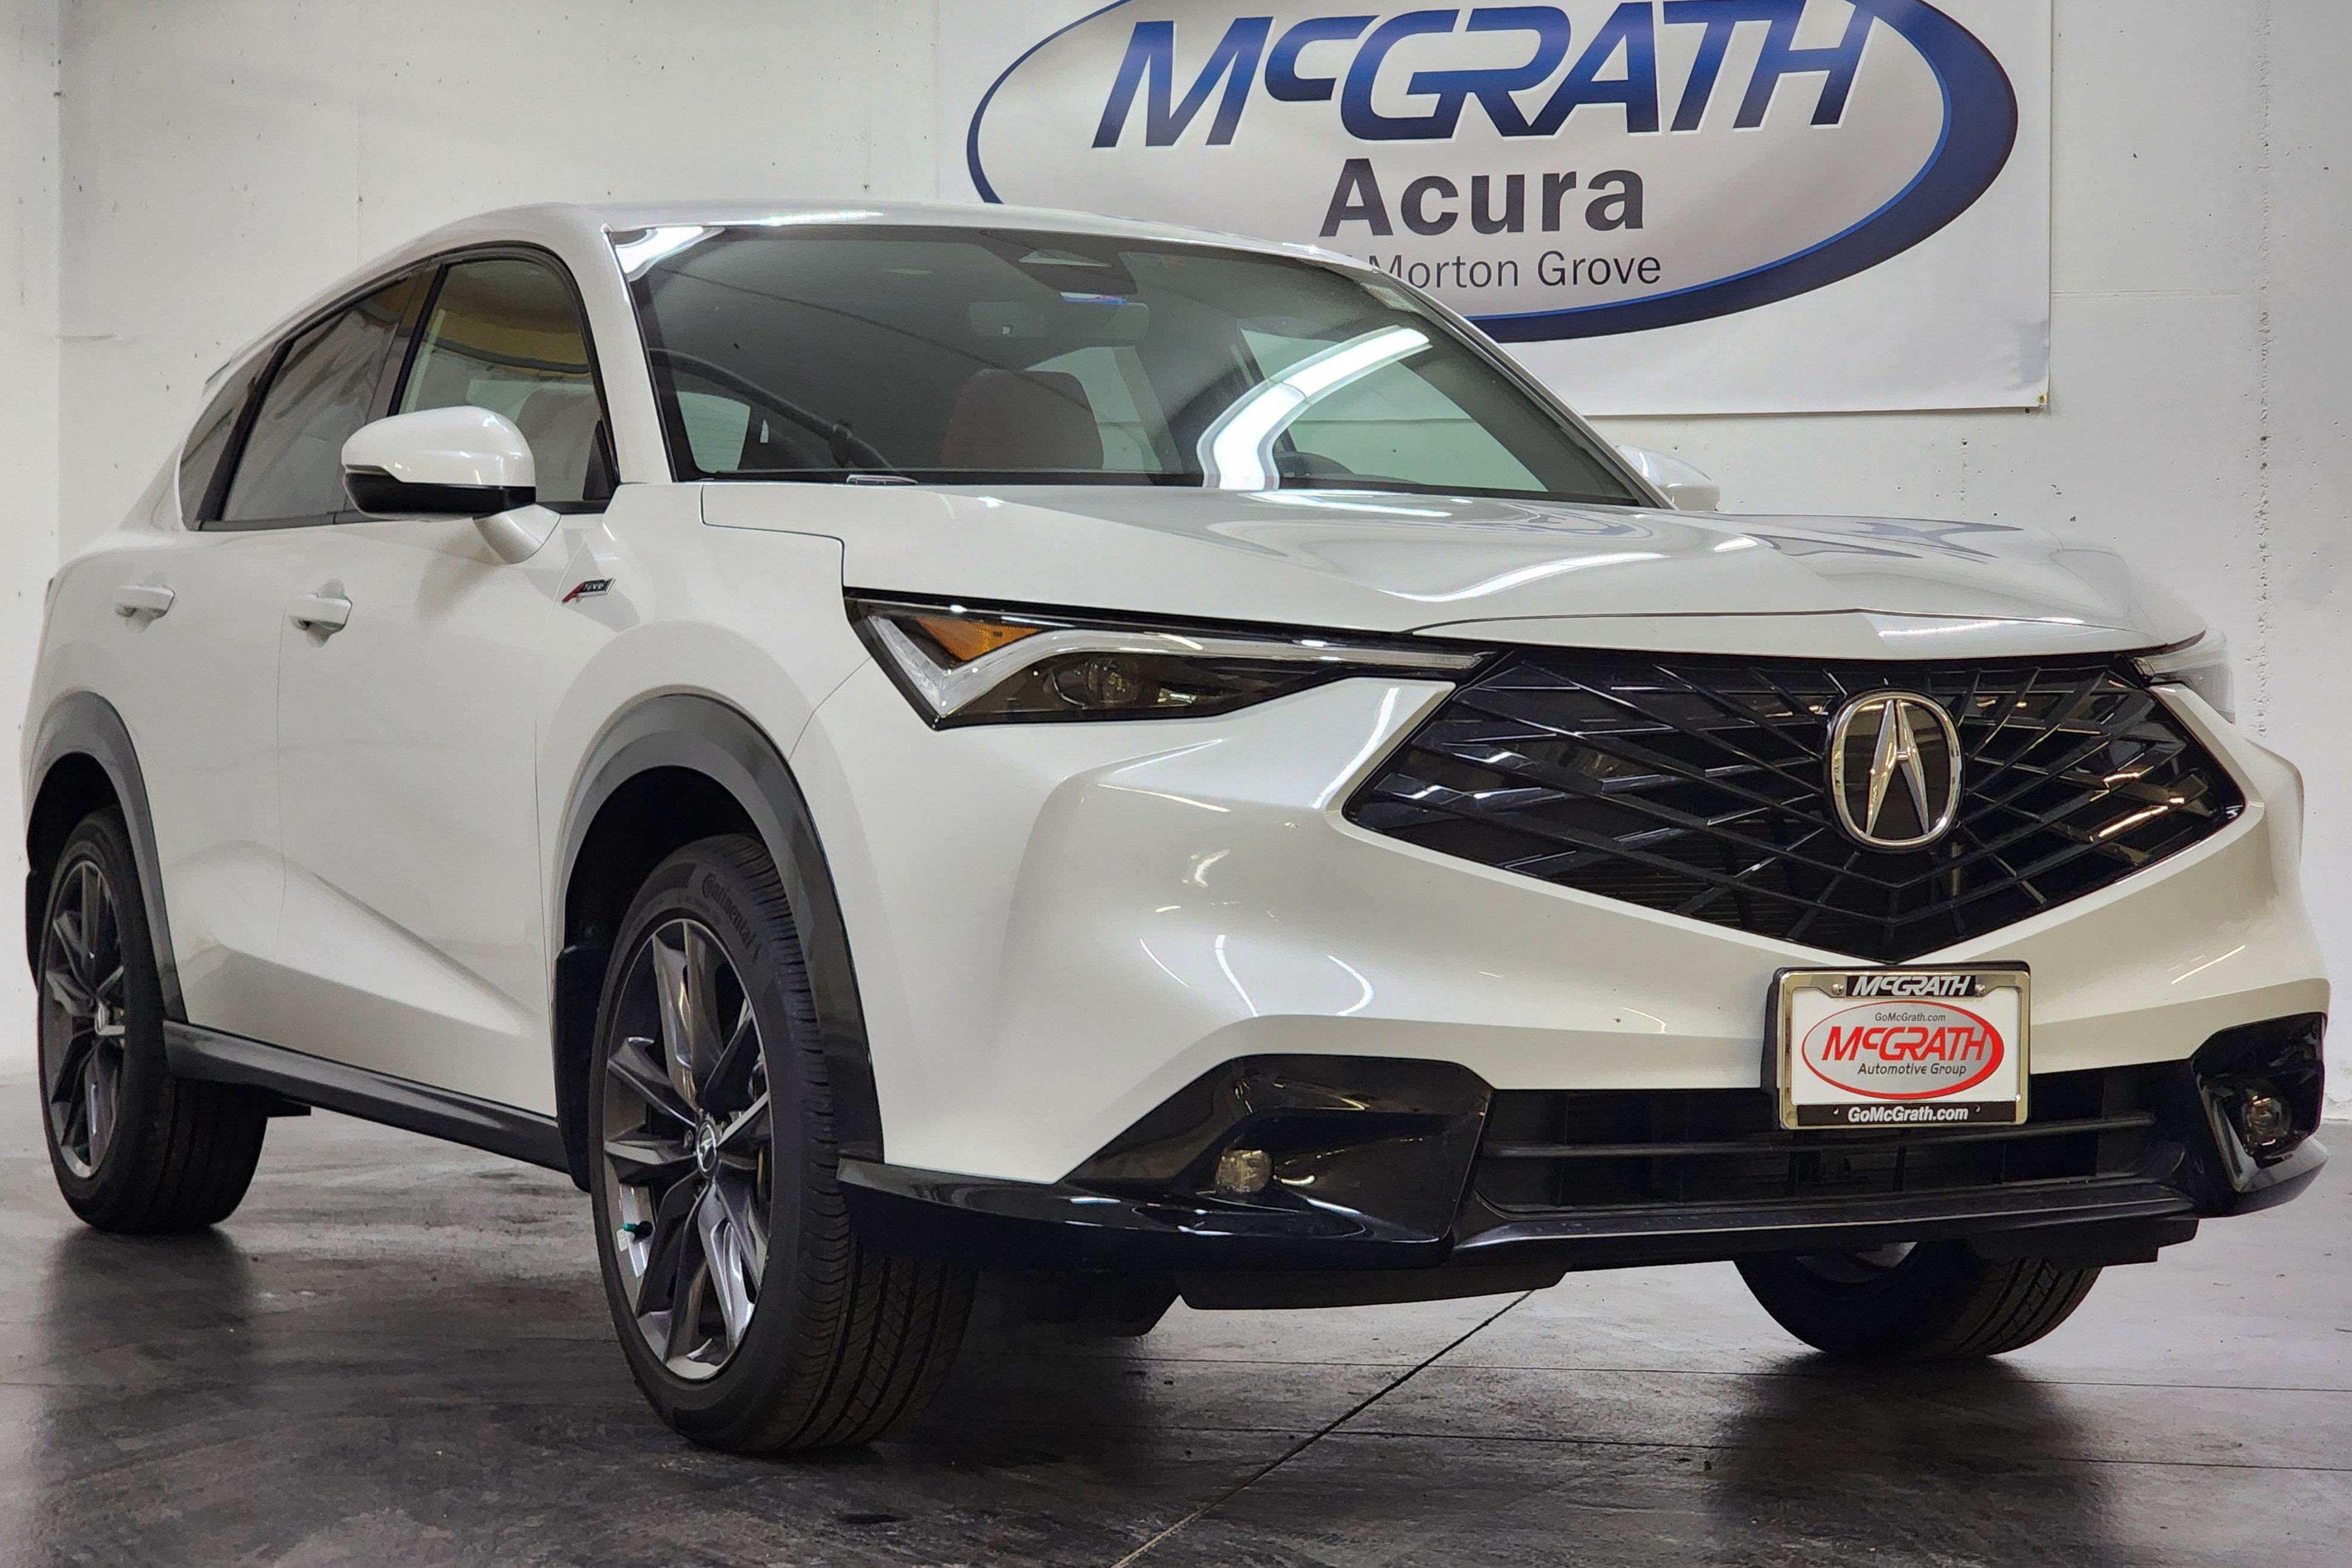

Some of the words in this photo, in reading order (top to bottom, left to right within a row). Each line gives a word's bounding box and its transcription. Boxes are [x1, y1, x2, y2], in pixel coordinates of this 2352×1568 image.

[1319, 157, 1644, 237] Acura
[1538, 250, 1662, 286] Grove
[702, 873, 758, 949] Continental
[1874, 1012, 1946, 1022] GoMcGrath.com
[1858, 1063, 1927, 1075] Automotive
[1930, 1062, 1967, 1077] Group
[1848, 1106, 1969, 1123] GoMcGrath.com
